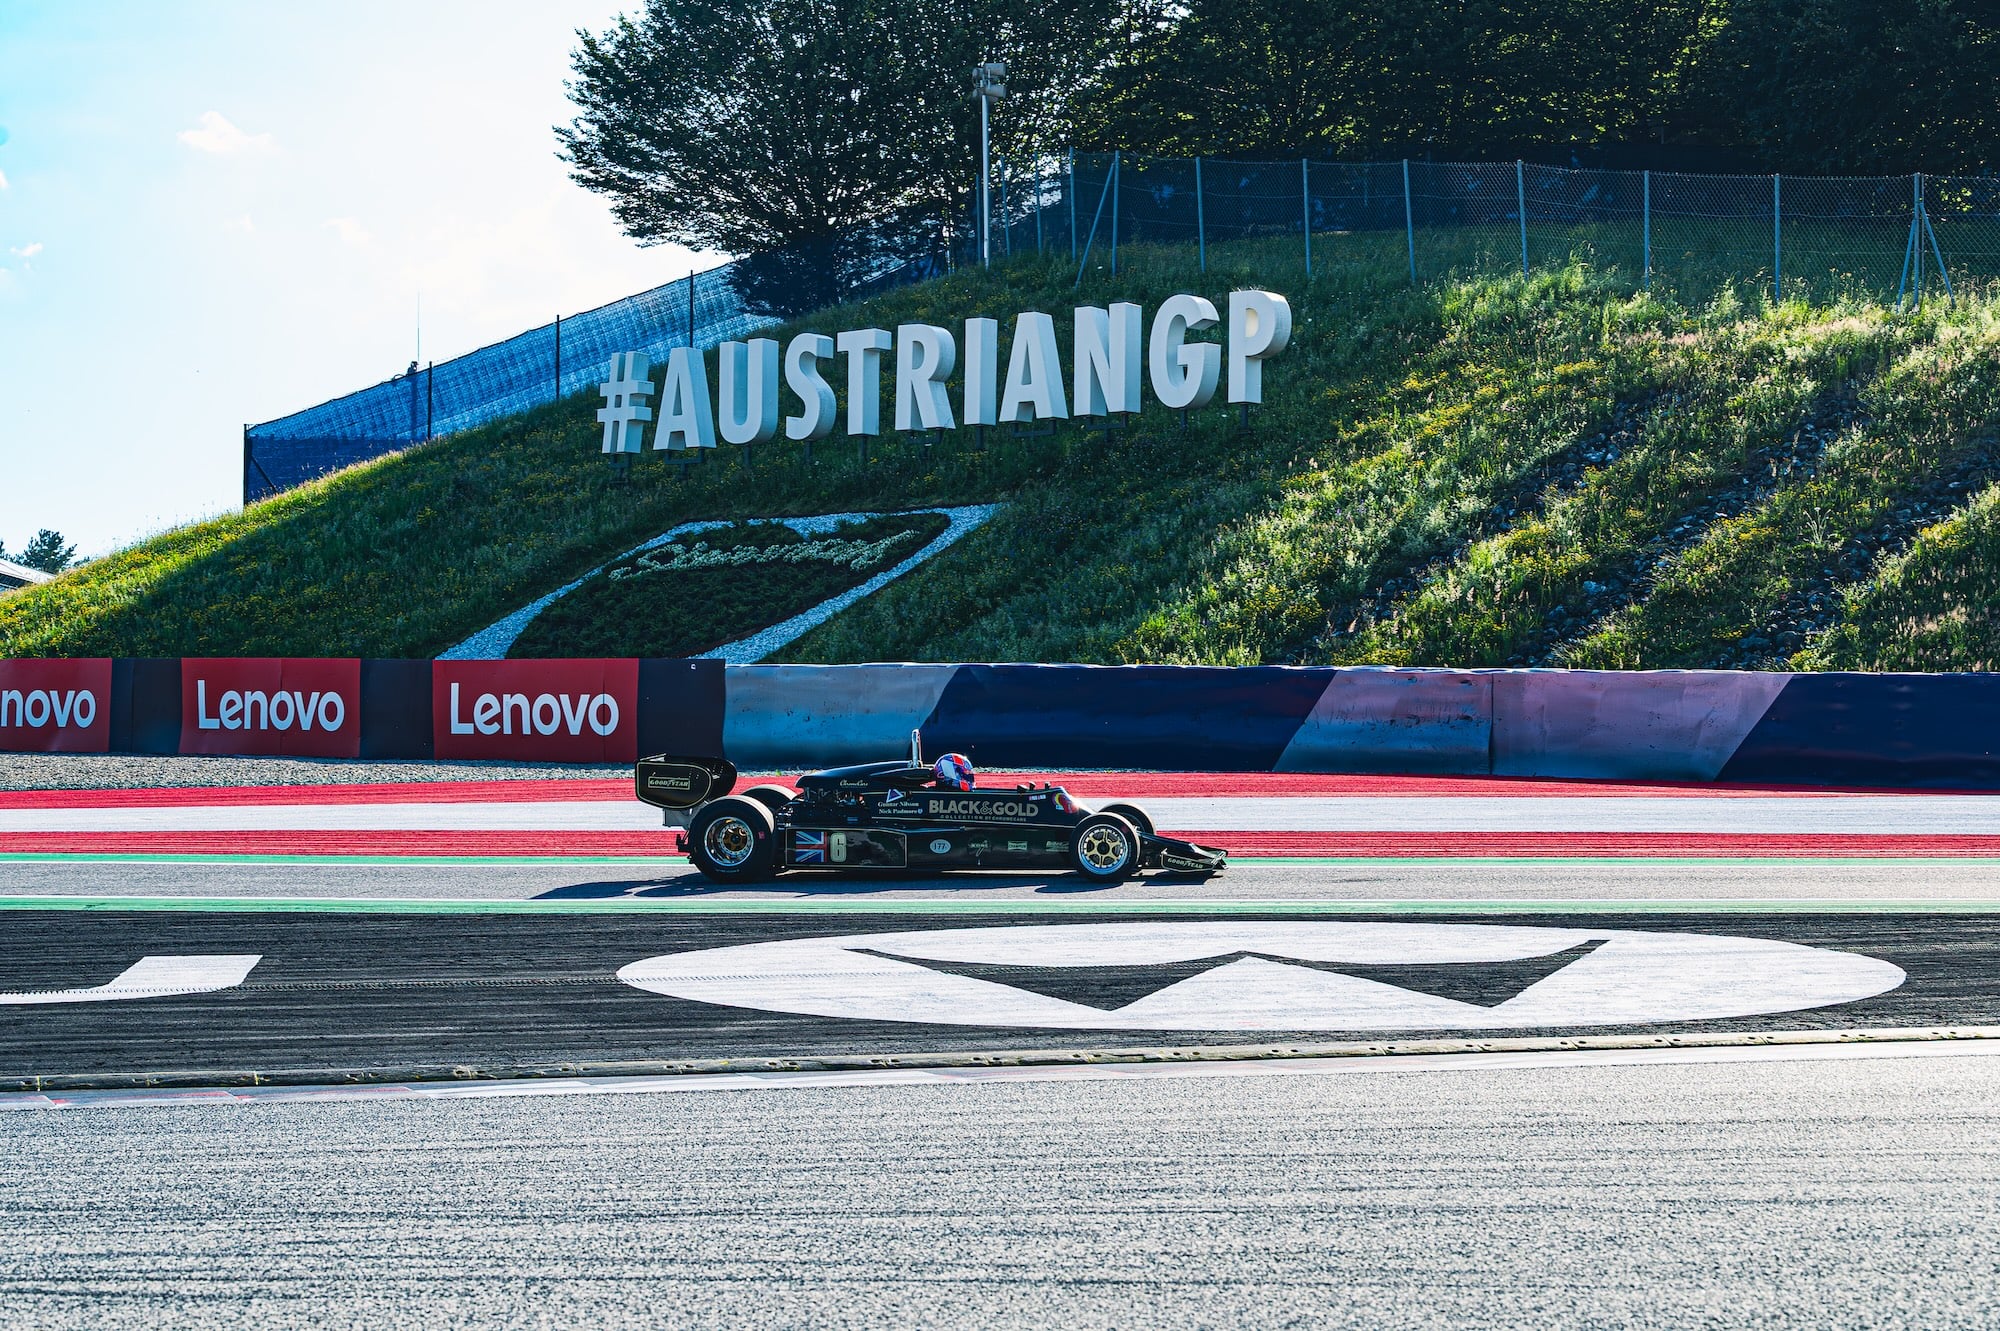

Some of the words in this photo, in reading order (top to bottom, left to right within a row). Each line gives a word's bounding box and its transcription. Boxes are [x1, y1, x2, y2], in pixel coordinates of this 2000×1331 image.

[596, 290, 1292, 455] #AUSTRIANGP
[1, 689, 97, 728] novo
[197, 679, 345, 732] Lenovo
[450, 682, 620, 736] Lenovo
[928, 799, 1039, 817] BLACK&GOLD
[830, 832, 847, 863] 6
[1167, 858, 1204, 869] GOODYEAR
